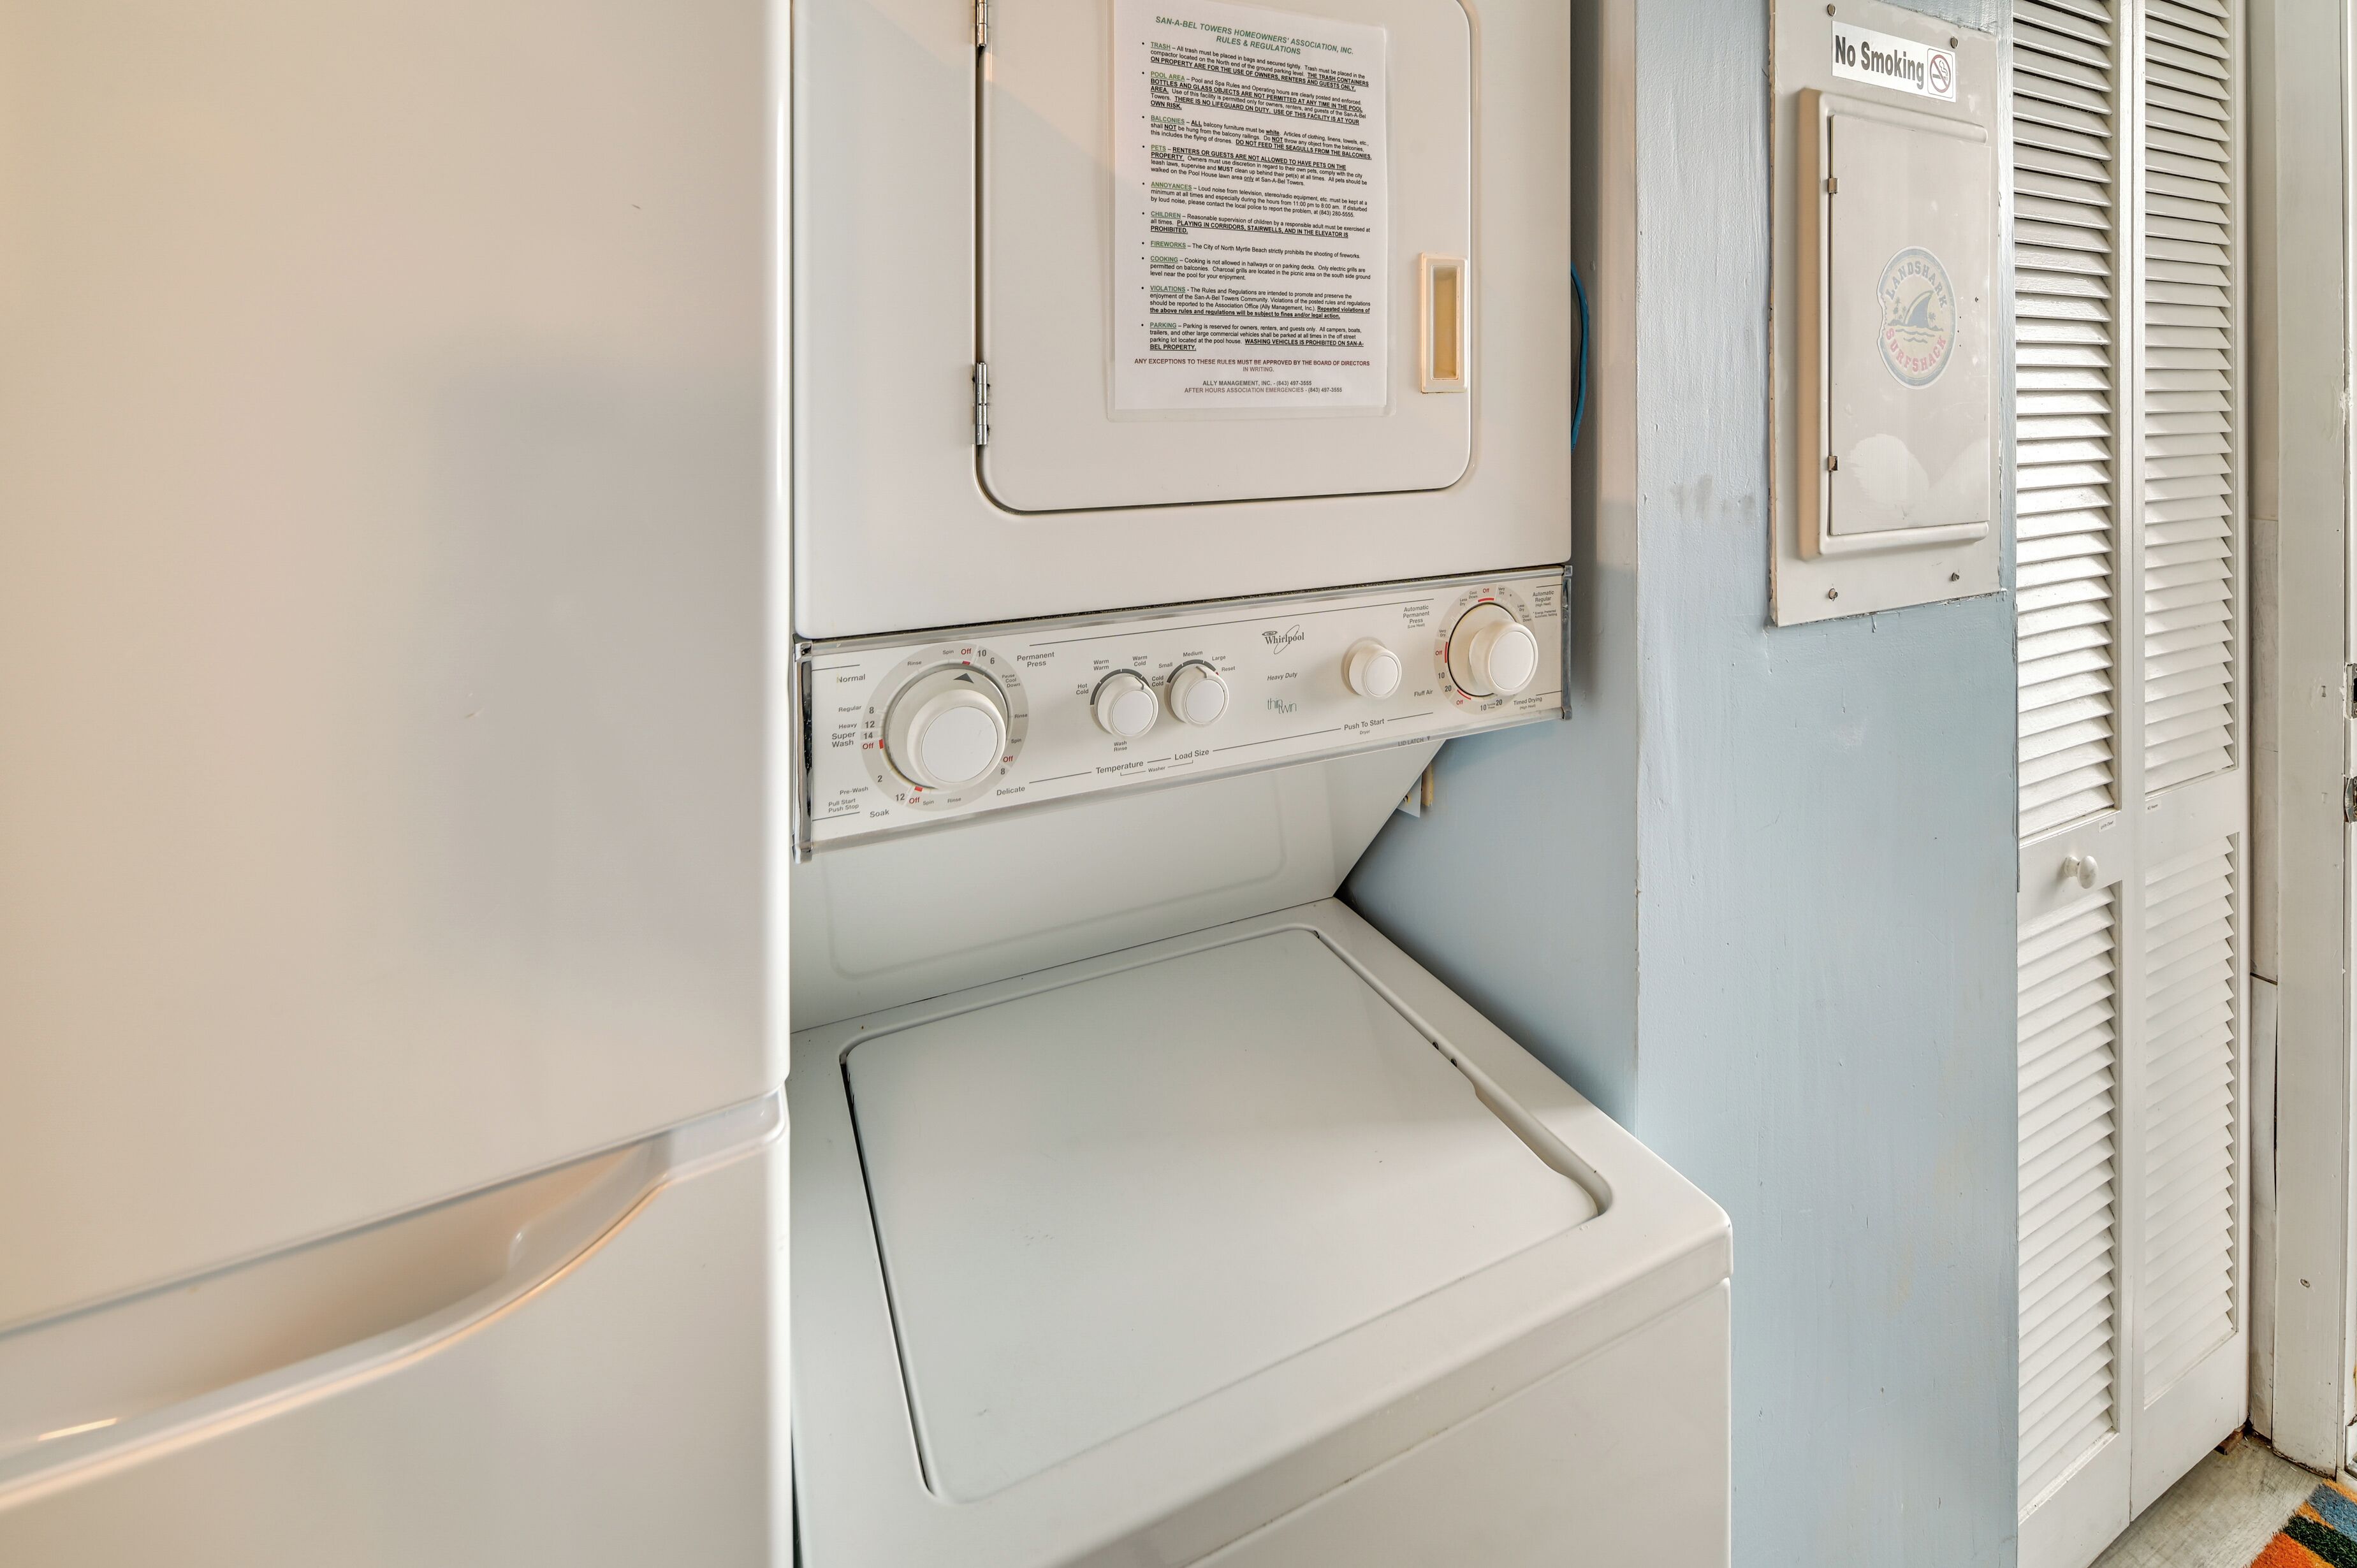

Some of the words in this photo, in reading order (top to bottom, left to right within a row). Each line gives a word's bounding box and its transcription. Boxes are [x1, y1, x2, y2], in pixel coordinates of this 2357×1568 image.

[1155, 16, 1197, 29] SAN-A-BEL
[1200, 24, 1232, 34] TOWERS
[1290, 38, 1338, 52] ASSOCIATION,
[1216, 36, 1241, 45] RULES
[1250, 41, 1301, 55] REGULATIONS
[1835, 35, 1856, 68] No
[1861, 41, 1924, 89] Smoking
[1151, 115, 1185, 124] BALCONIES
[1151, 182, 1192, 190] ANNOYANCES
[1886, 261, 1948, 309] LANDSHARK
[1265, 632, 1304, 644] Whirlpool
[1017, 651, 1054, 661] Permanent
[836, 674, 866, 683] Normal
[1267, 673, 1283, 681] Heavy
[838, 704, 861, 713] Regular
[1344, 722, 1359, 731] Push
[832, 731, 856, 741] Super
[832, 739, 854, 748] Wash
[1174, 751, 1192, 760] Load
[1194, 748, 1209, 757] Size
[1096, 760, 1144, 774] Temperature
[840, 786, 868, 795] Pre-Wash
[996, 786, 1025, 795] Delicate
[845, 803, 859, 811] Stop
[870, 809, 889, 818] Soak
